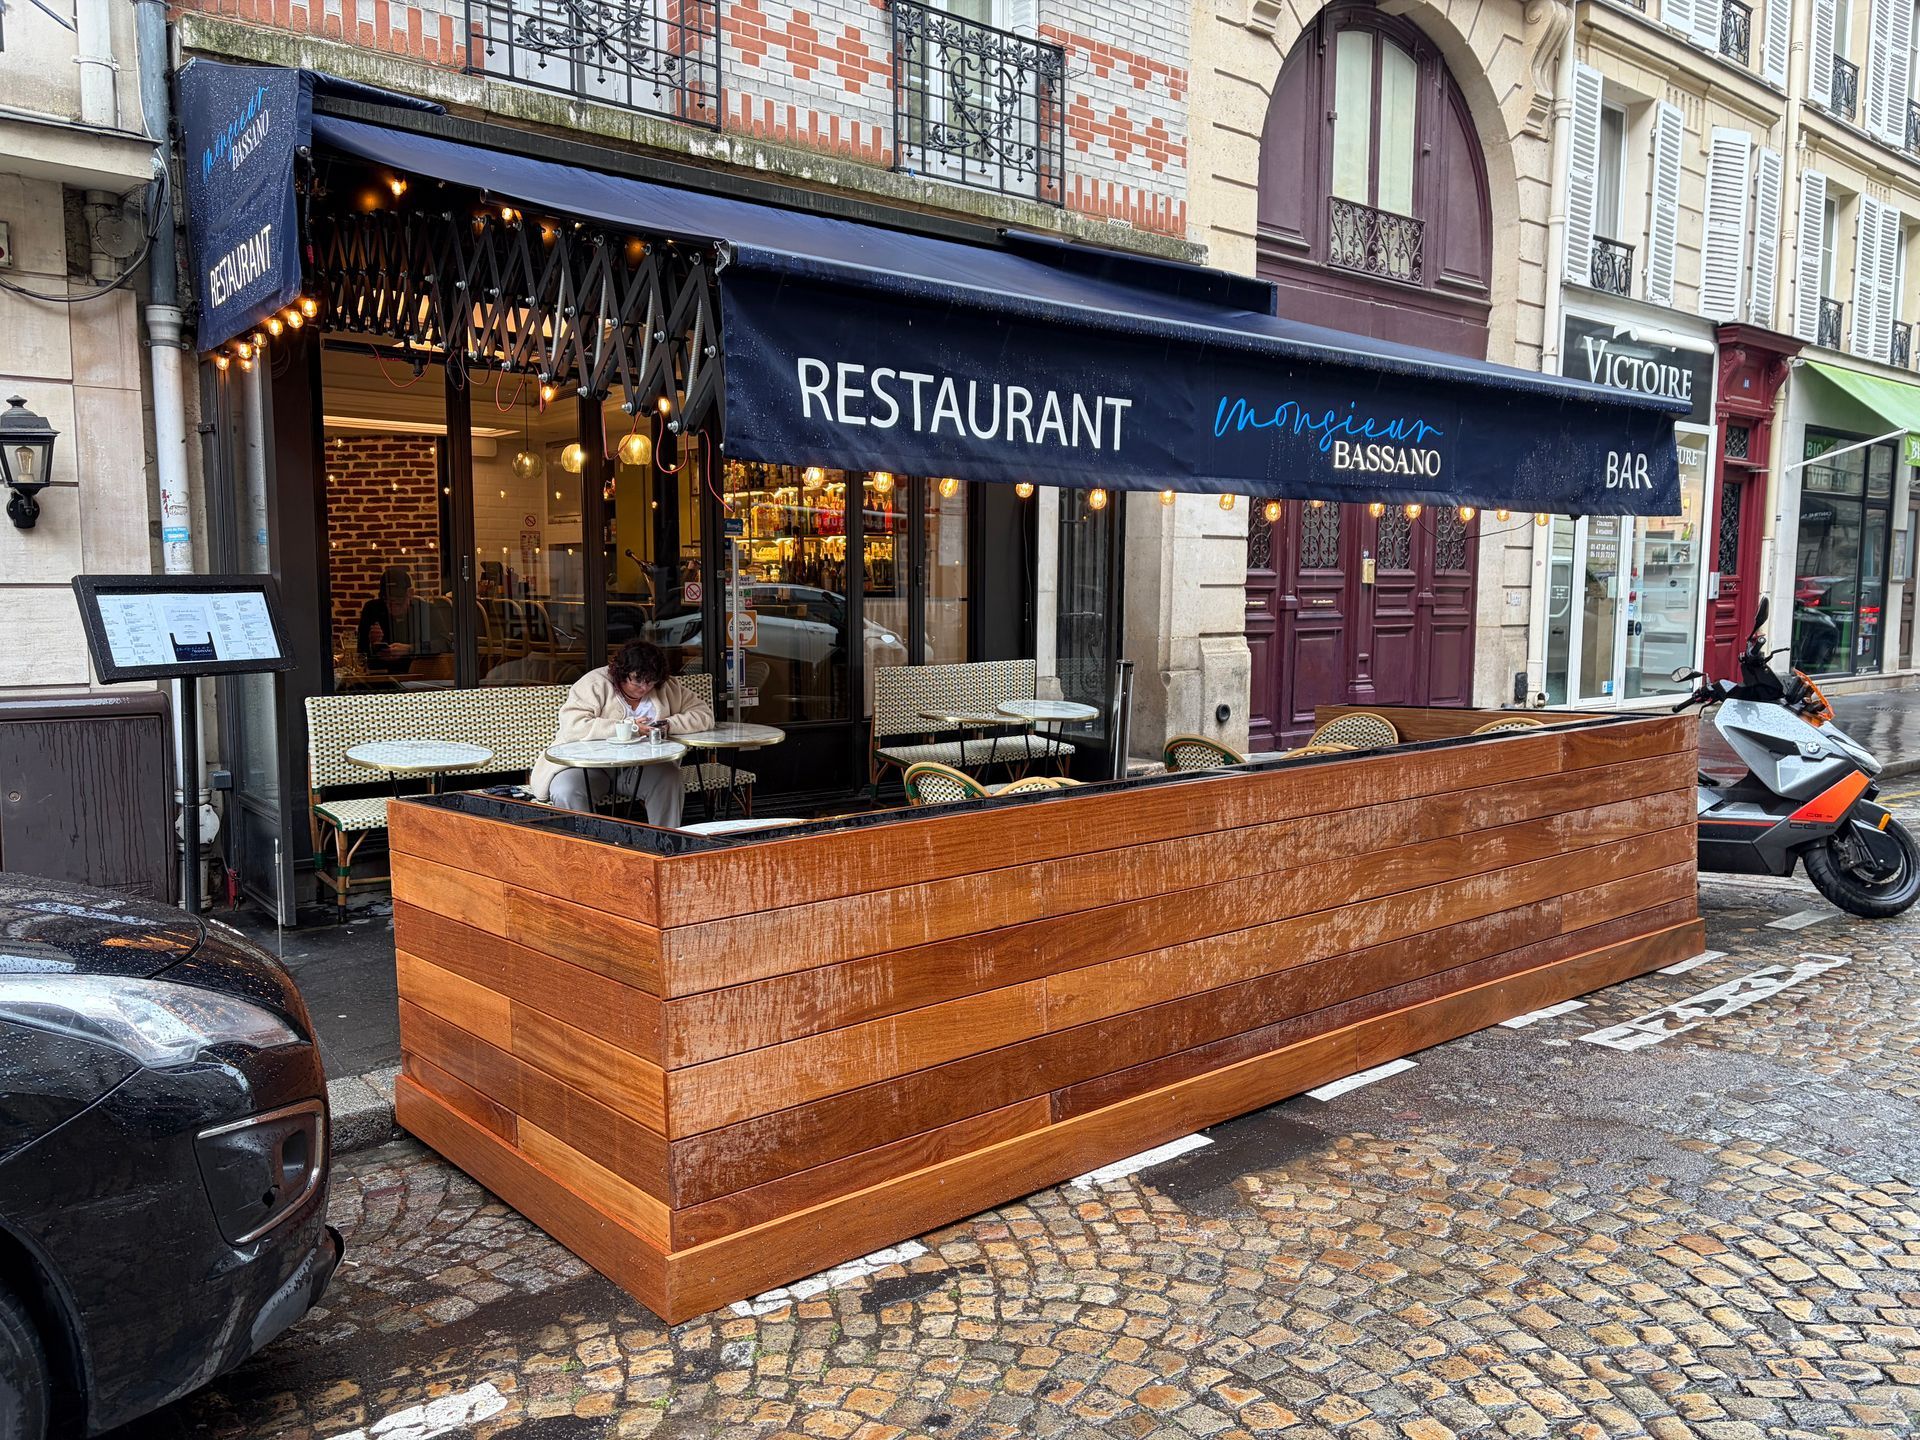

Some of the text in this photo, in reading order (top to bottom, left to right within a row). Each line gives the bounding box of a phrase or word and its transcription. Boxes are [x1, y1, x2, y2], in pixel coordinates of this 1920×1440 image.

[231, 109, 270, 171] BASSANO
[210, 223, 272, 309] RESTAURANT
[797, 357, 1132, 451] RESTAURANT
[1333, 440, 1442, 477] BASSANO
[1606, 450, 1653, 489] BAR
